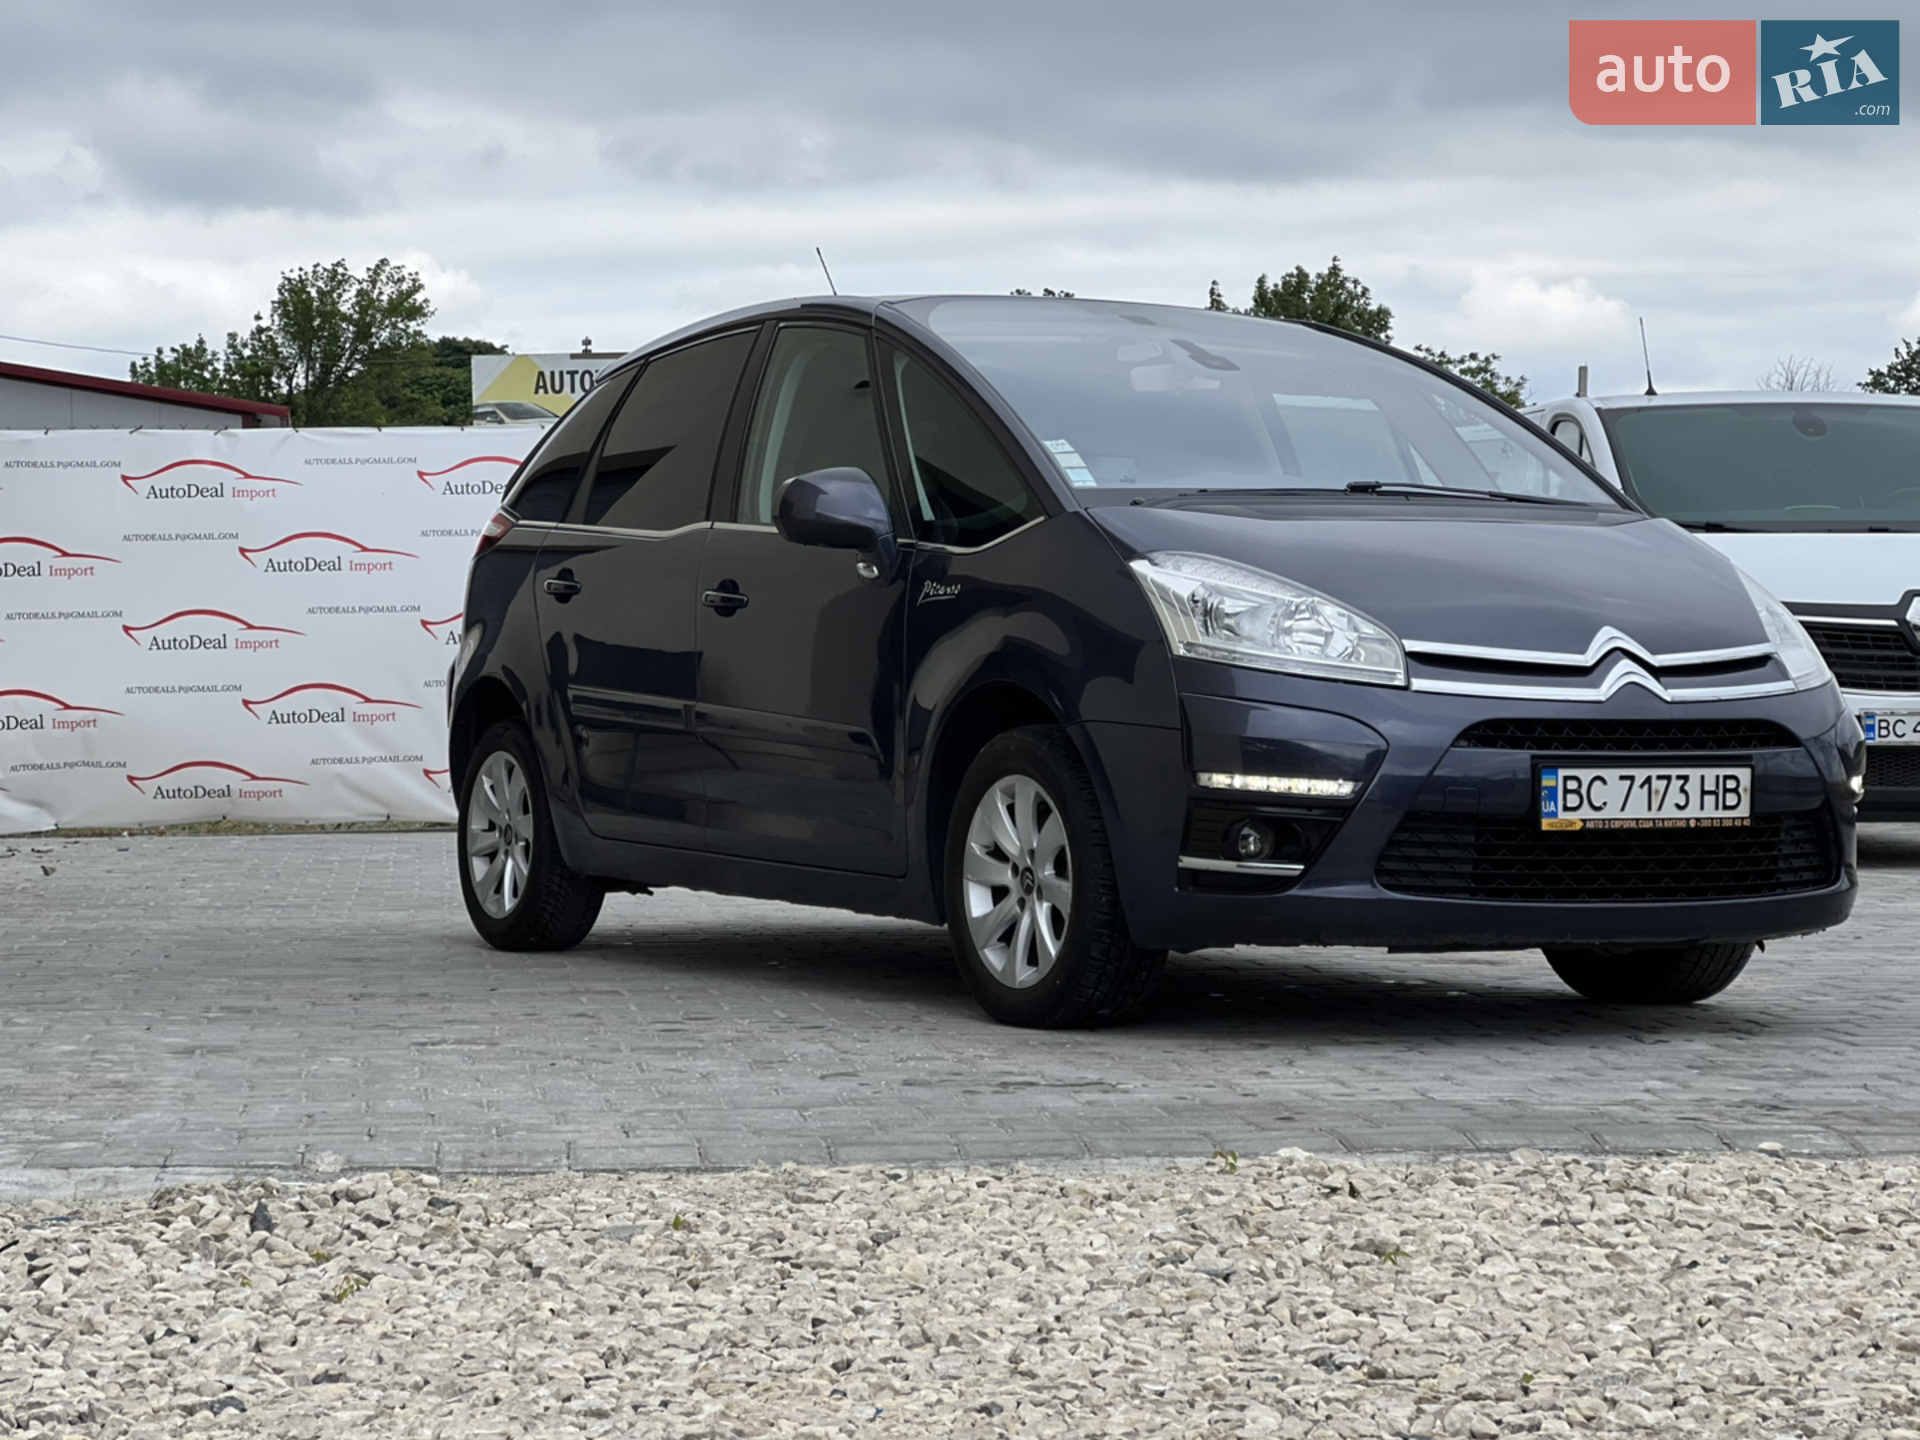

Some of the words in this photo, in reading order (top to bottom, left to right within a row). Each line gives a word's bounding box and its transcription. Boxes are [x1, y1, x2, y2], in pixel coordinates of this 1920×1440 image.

[534, 369, 599, 396] AUTO
[145, 482, 225, 499] AutoDeal
[231, 486, 277, 501] Import
[441, 480, 505, 496] AutoDe
[48, 564, 95, 580] Import
[263, 555, 343, 574] AutoDeal
[348, 559, 394, 575] Import
[147, 633, 228, 651] AutoDeal
[234, 637, 280, 653] Import
[51, 717, 98, 733] Import
[267, 706, 346, 725] AutoDeal
[352, 711, 397, 726] Import
[1878, 719, 1907, 739] BC
[153, 783, 232, 801] AutoDeal
[239, 788, 284, 802] Import
[1562, 774, 1609, 813] BC
[1618, 774, 1691, 813] 7173
[1699, 774, 1742, 812] HB
[1542, 800, 1557, 813] UA
